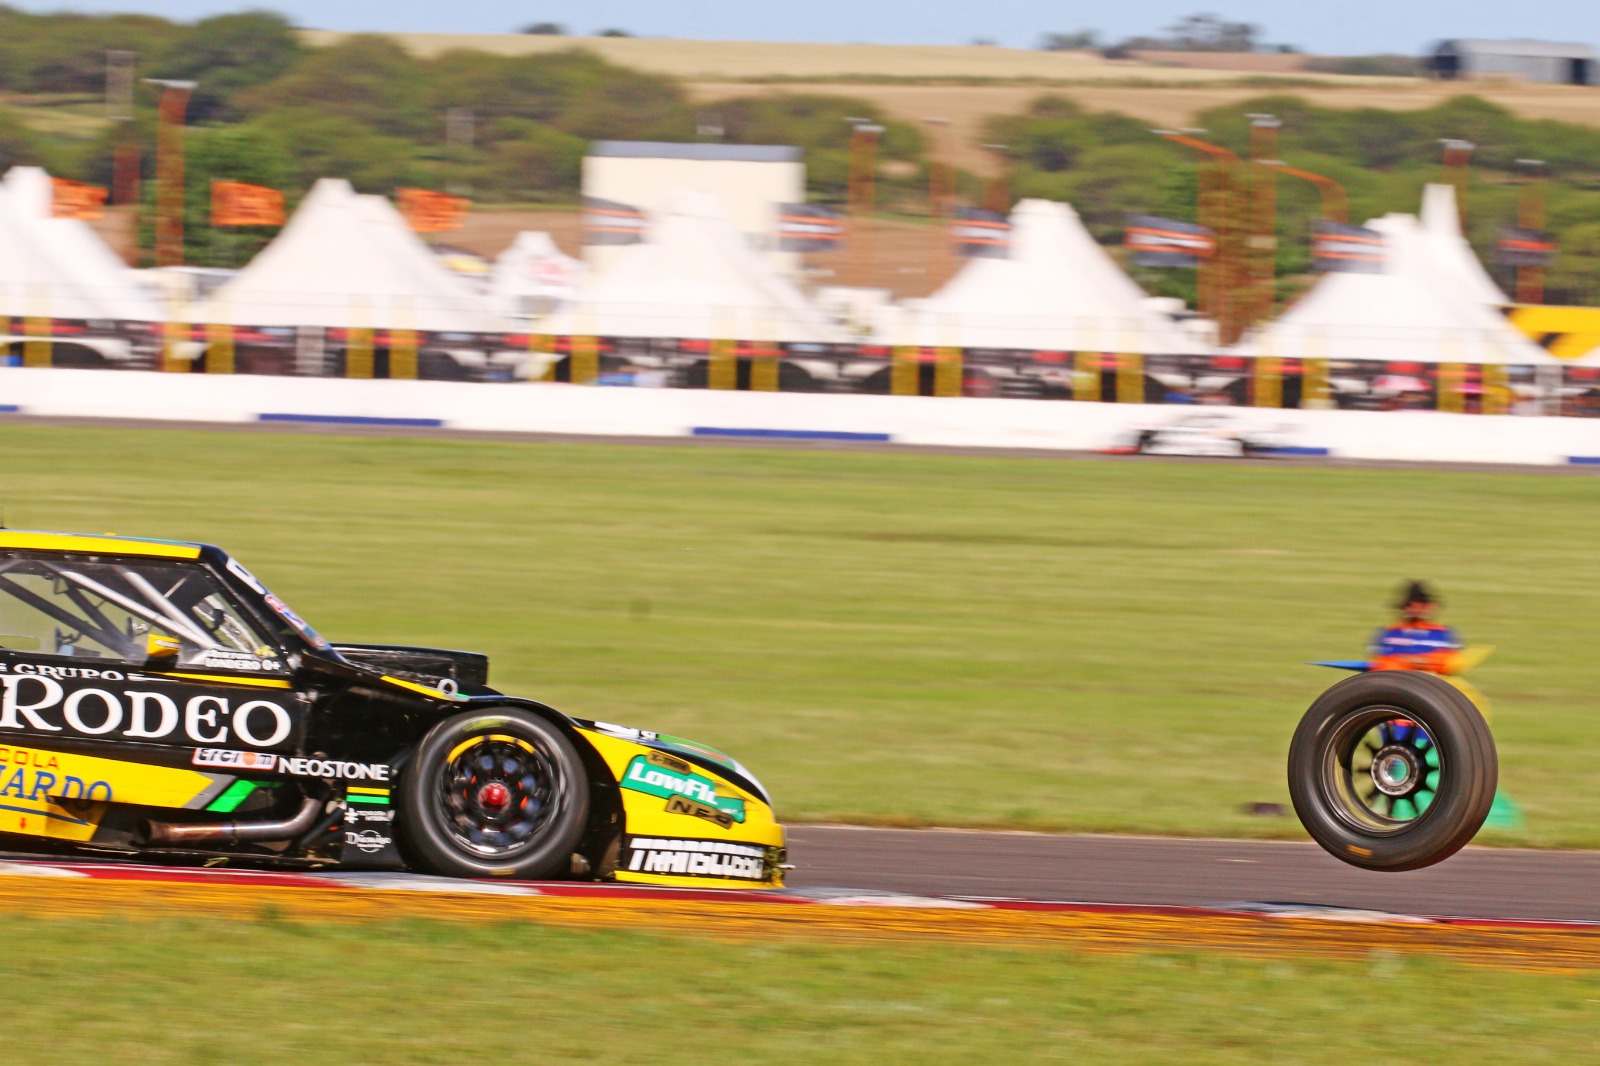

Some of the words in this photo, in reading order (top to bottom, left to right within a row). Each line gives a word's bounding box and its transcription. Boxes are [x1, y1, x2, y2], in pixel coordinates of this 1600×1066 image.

[13, 663, 124, 681] GRUPO
[0, 673, 292, 747] RODEO
[278, 757, 390, 781] NEOSTONE
[672, 799, 731, 826] NEO
